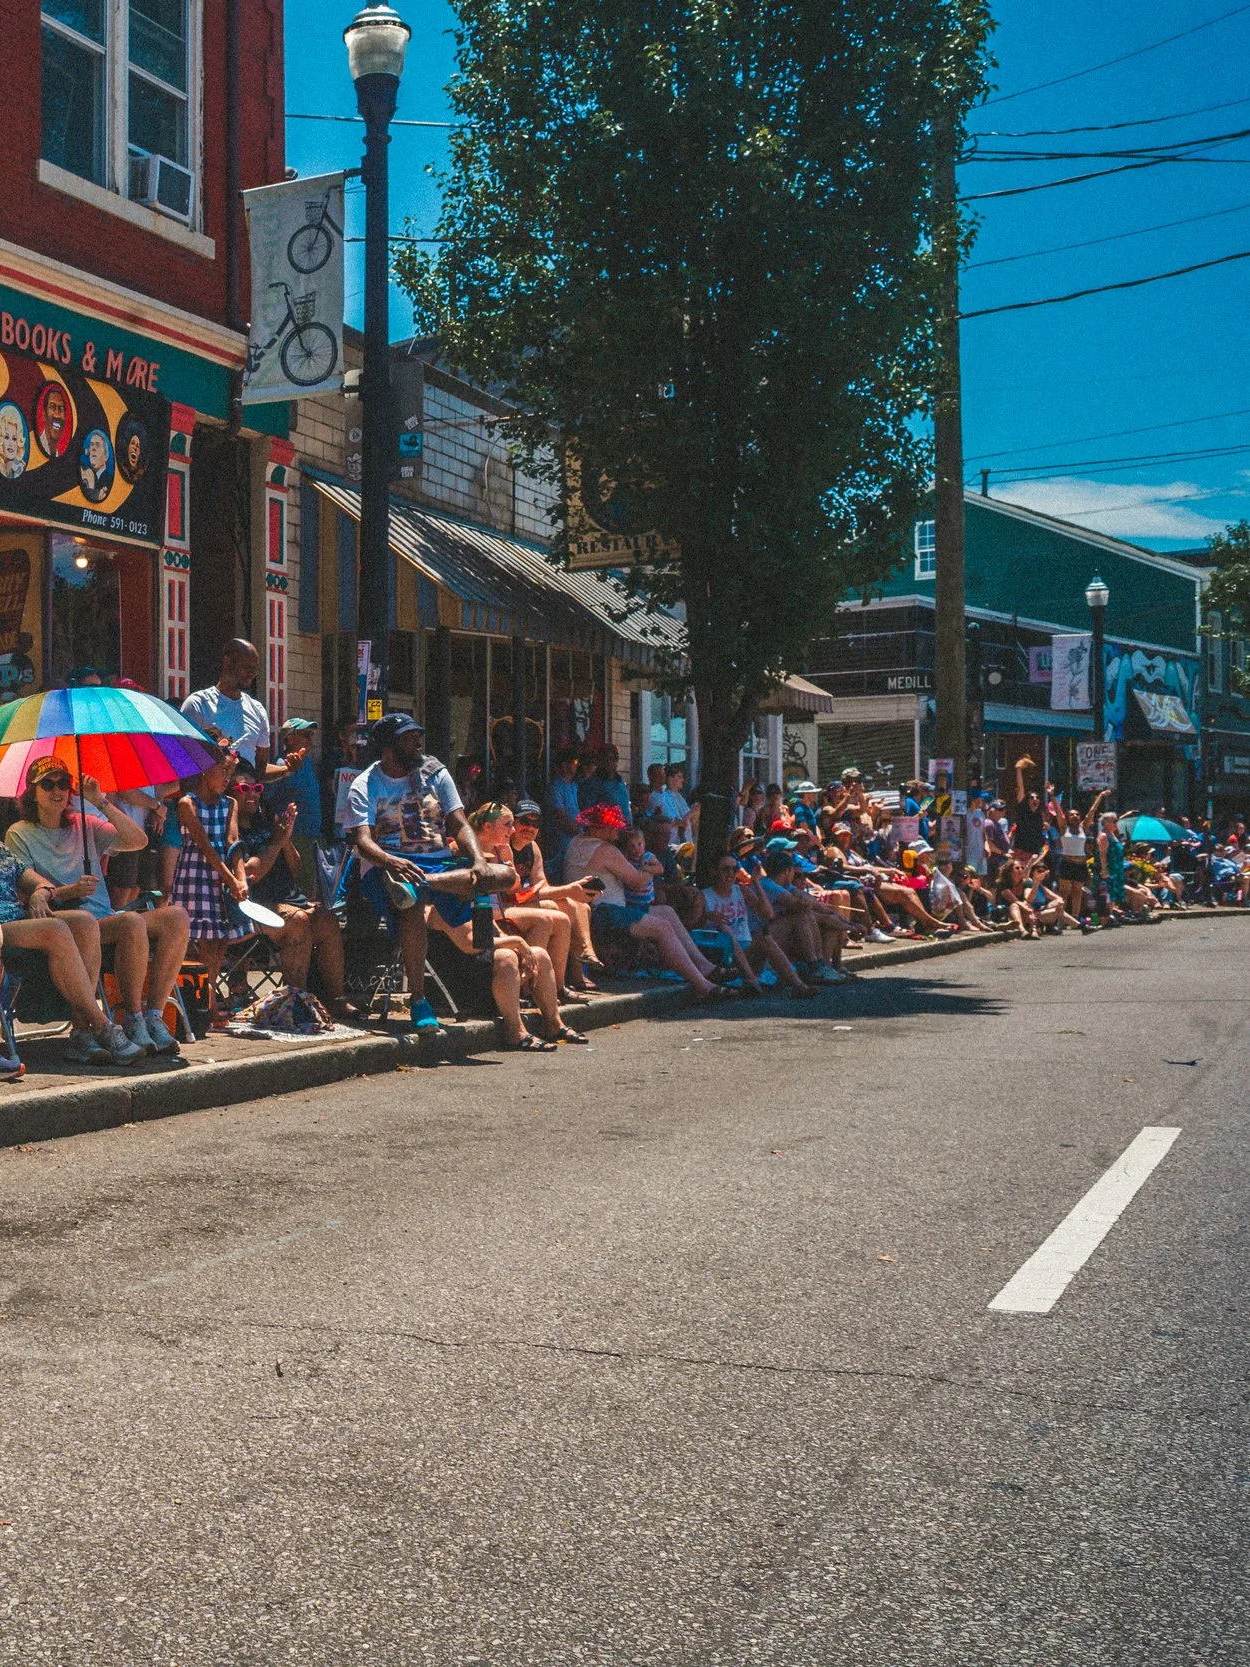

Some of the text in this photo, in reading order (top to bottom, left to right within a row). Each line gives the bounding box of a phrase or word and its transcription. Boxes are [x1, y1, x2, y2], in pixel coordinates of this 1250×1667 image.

[0, 310, 72, 364] BOOKS
[82, 341, 96, 374] &
[81, 508, 148, 535] Phone 591-0123
[888, 675, 931, 690] MEDILL
